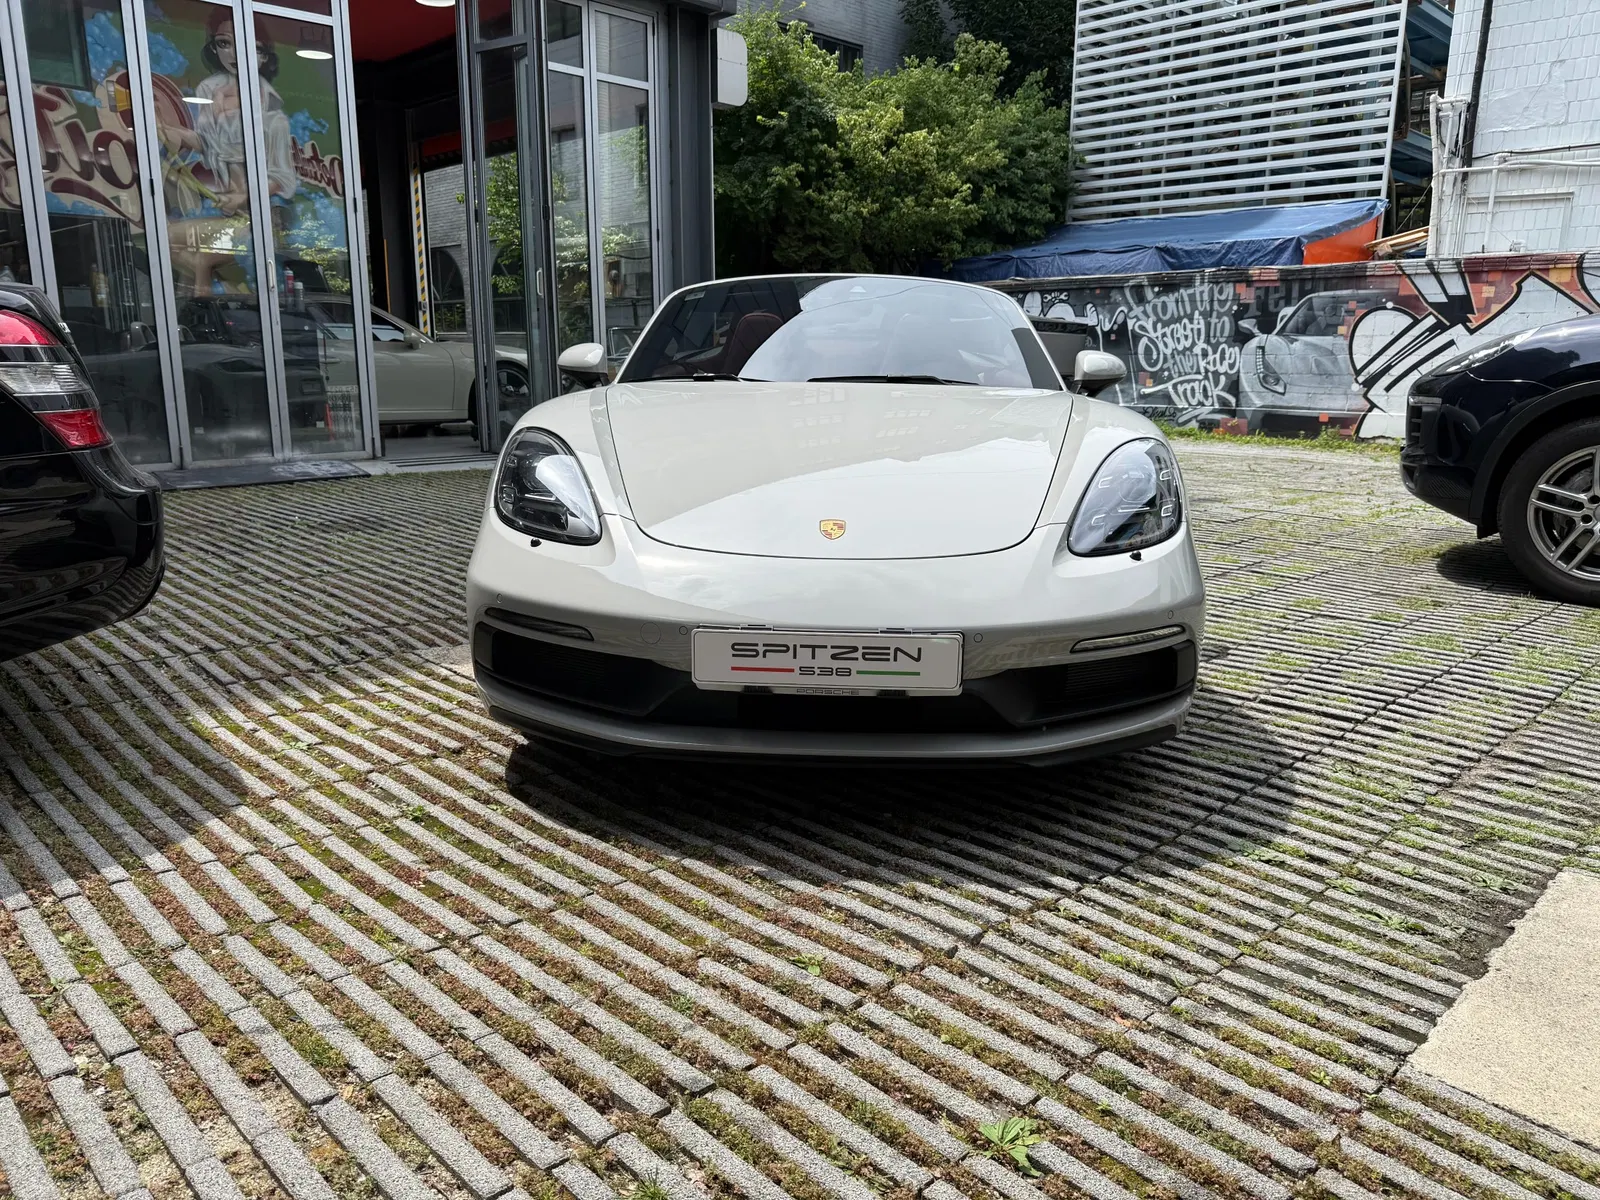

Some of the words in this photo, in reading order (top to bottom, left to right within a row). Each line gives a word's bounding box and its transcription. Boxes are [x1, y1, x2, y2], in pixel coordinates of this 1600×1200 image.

[1187, 273, 1234, 312] the
[1134, 310, 1205, 372] Street
[1209, 311, 1230, 344] to
[1163, 350, 1197, 378] the
[731, 642, 922, 663] SPITZEN
[796, 688, 860, 696] PORSCHE
